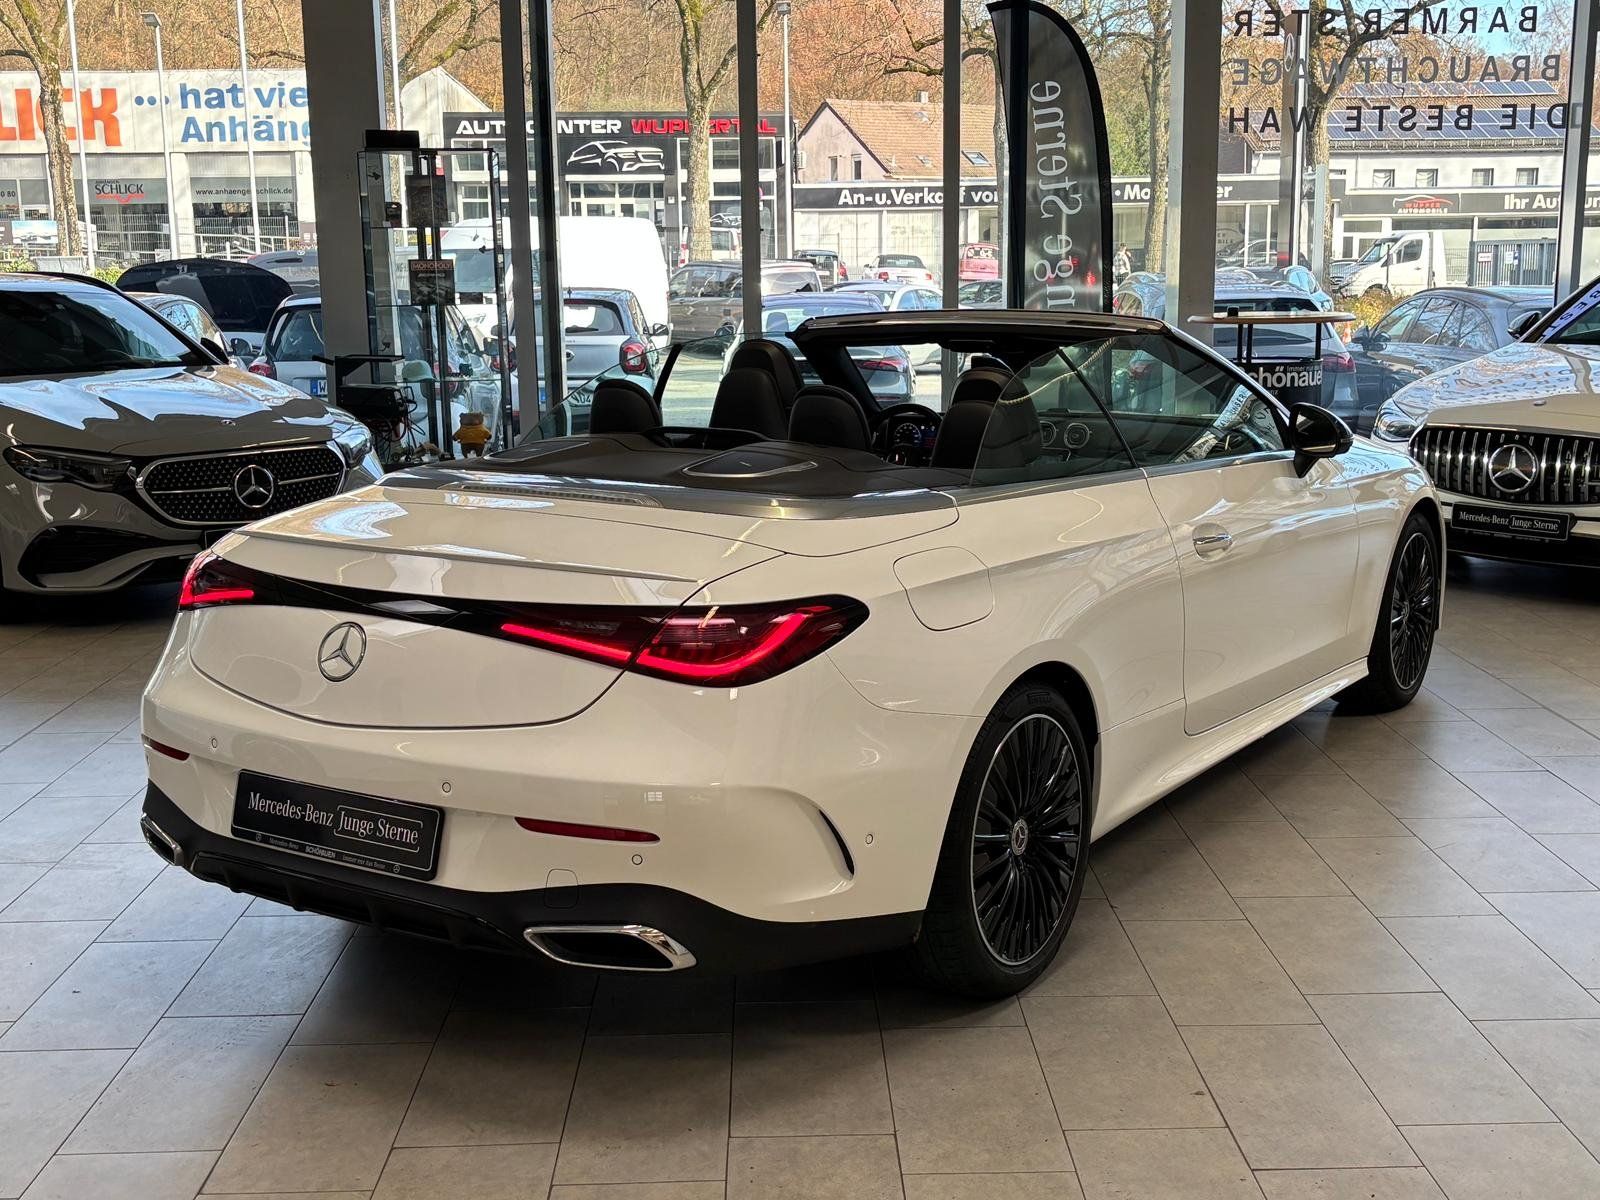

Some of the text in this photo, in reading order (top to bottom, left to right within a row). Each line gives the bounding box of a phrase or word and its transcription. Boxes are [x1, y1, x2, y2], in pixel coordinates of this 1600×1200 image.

[179, 82, 246, 109] hat
[95, 183, 145, 195] SCHLICK
[1504, 193, 1561, 210] Ihr Au
[1459, 511, 1558, 531] Mercedes-Benz Junge Sterne
[248, 791, 419, 844] Mercedes-Benz Junge Sterne
